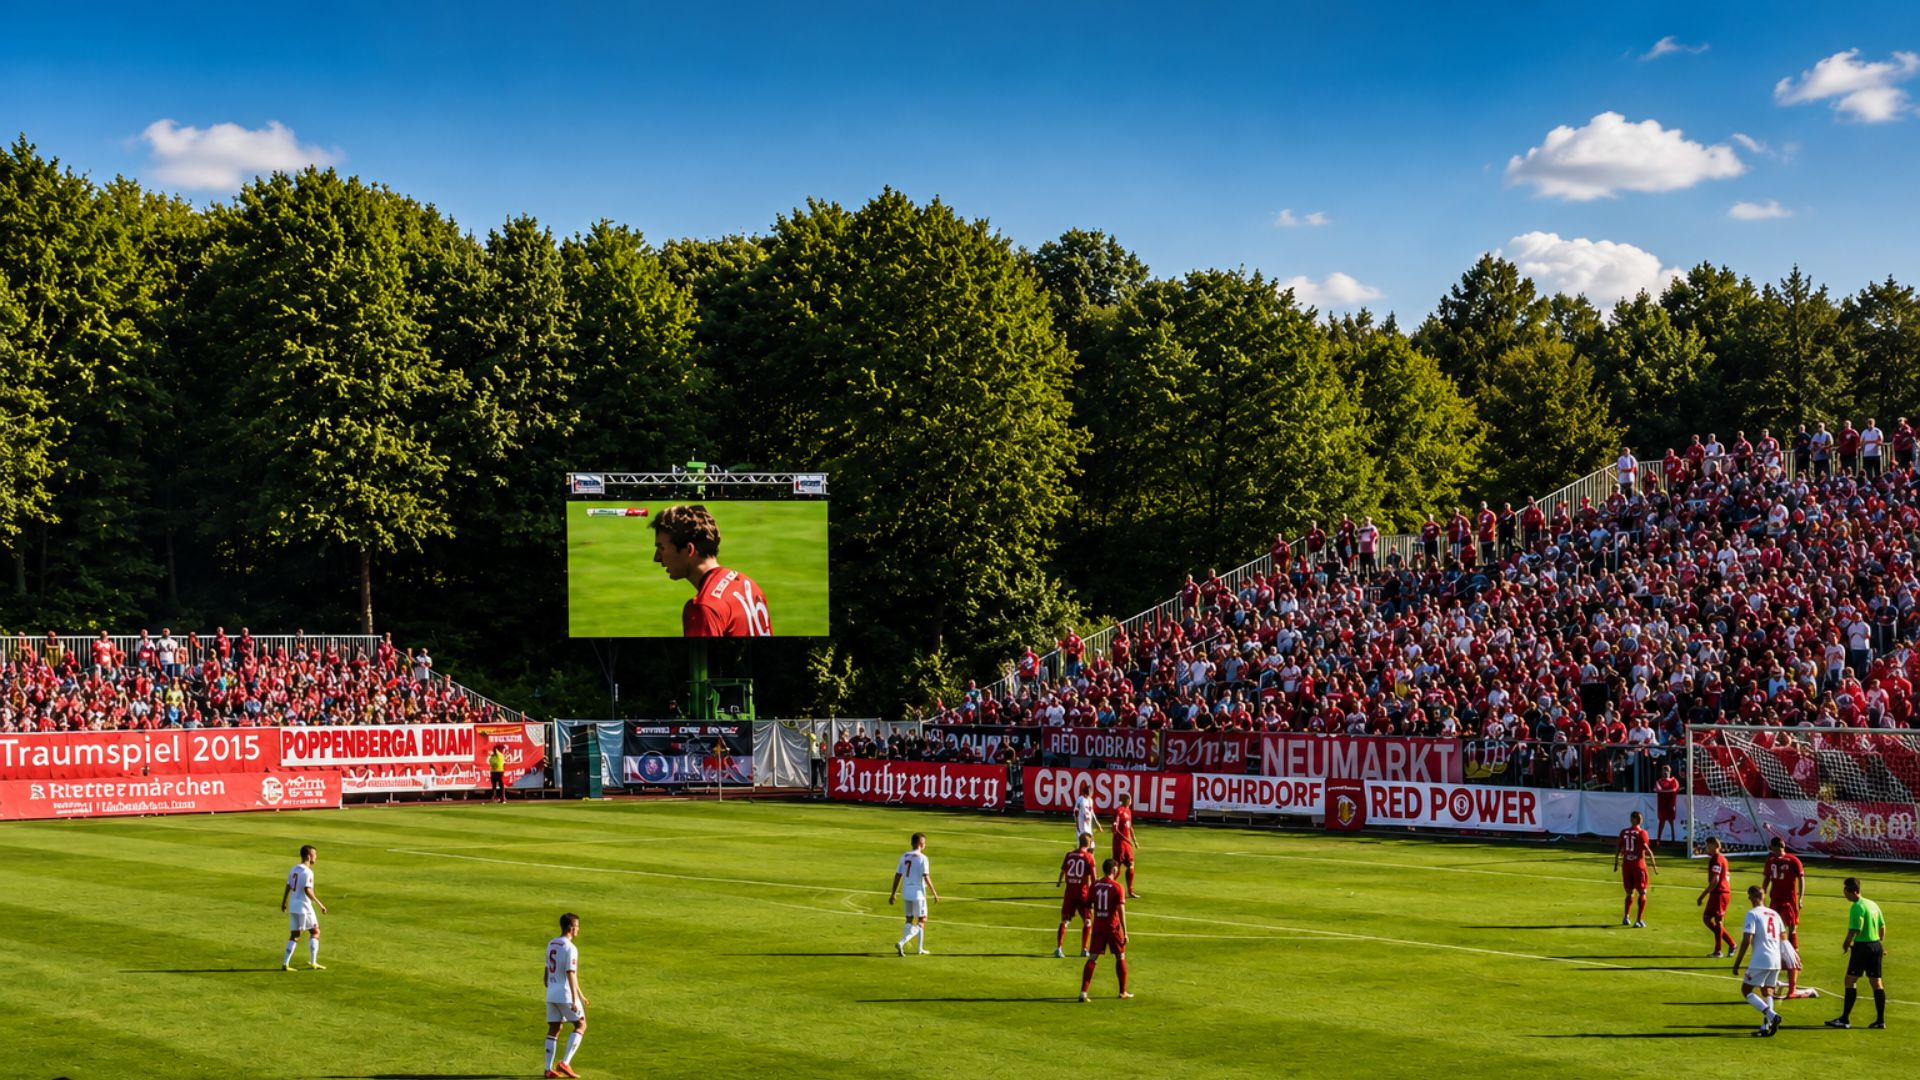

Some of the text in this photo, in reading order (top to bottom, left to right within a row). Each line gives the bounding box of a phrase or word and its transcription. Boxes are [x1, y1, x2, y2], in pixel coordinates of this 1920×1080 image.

[0, 734, 260, 771] Traumspiel 2015
[282, 729, 418, 760] POPPENBERGA
[422, 728, 473, 757] BUAM
[1051, 733, 1079, 755] RED
[1085, 734, 1146, 759] COBRAS
[1263, 737, 1455, 784] NEUMARKT
[1034, 768, 1176, 814] GROSBLIE
[1196, 777, 1322, 807] ROHRDORF
[1370, 785, 1536, 825] RED POWER
[1067, 858, 1085, 877] 20
[1096, 888, 1109, 910] 11
